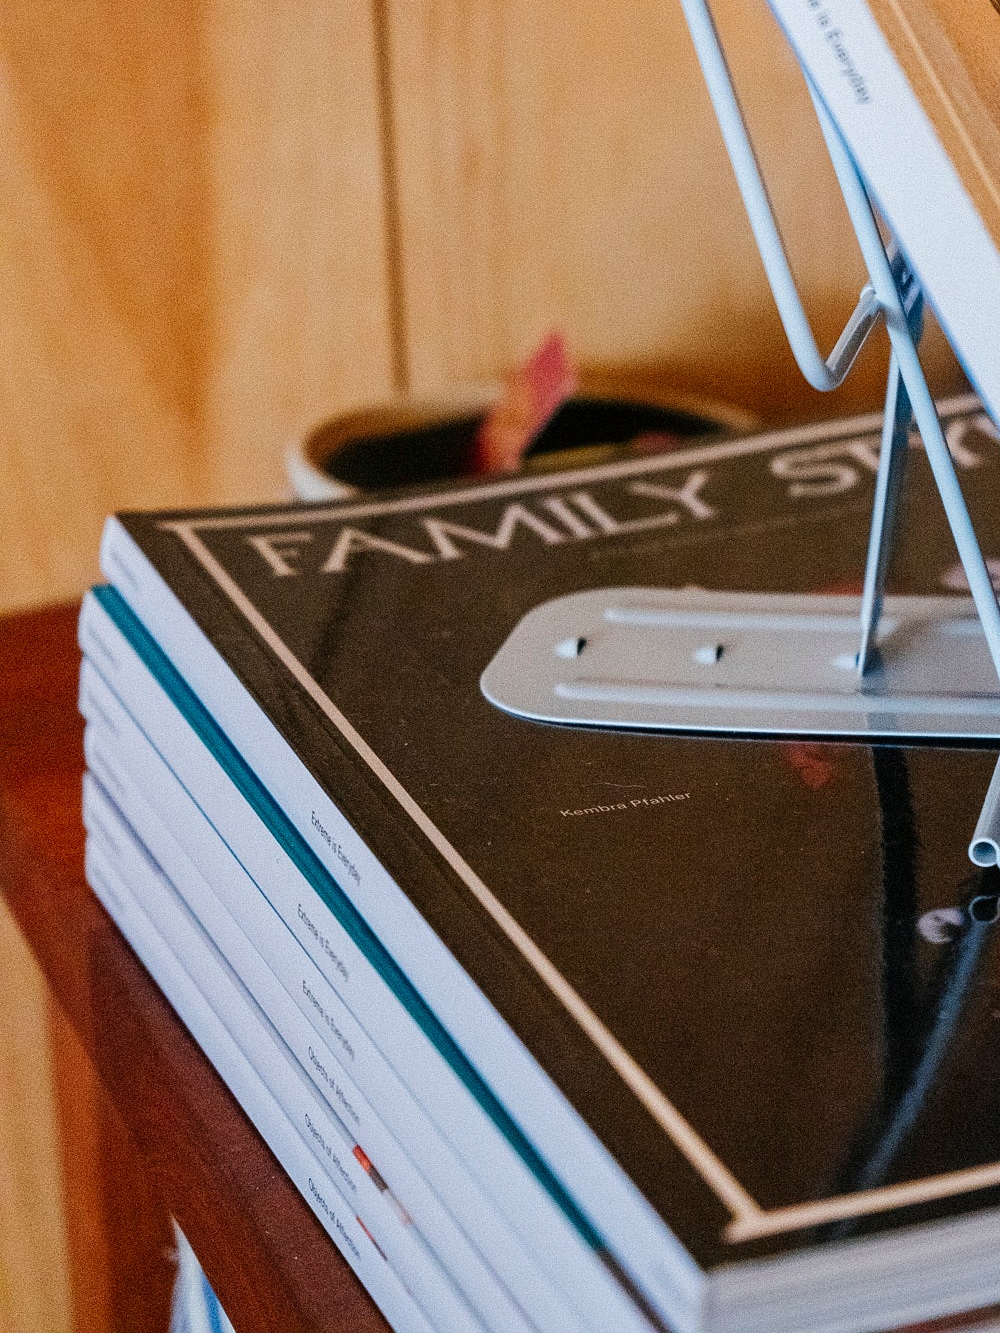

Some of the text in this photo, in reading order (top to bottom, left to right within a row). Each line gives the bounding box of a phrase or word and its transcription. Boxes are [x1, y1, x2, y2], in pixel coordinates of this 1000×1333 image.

[818, 10, 831, 29] is
[827, 28, 872, 104] Everyday
[247, 469, 715, 576] FAMILY
[560, 792, 691, 817] Kembra Pfahler
